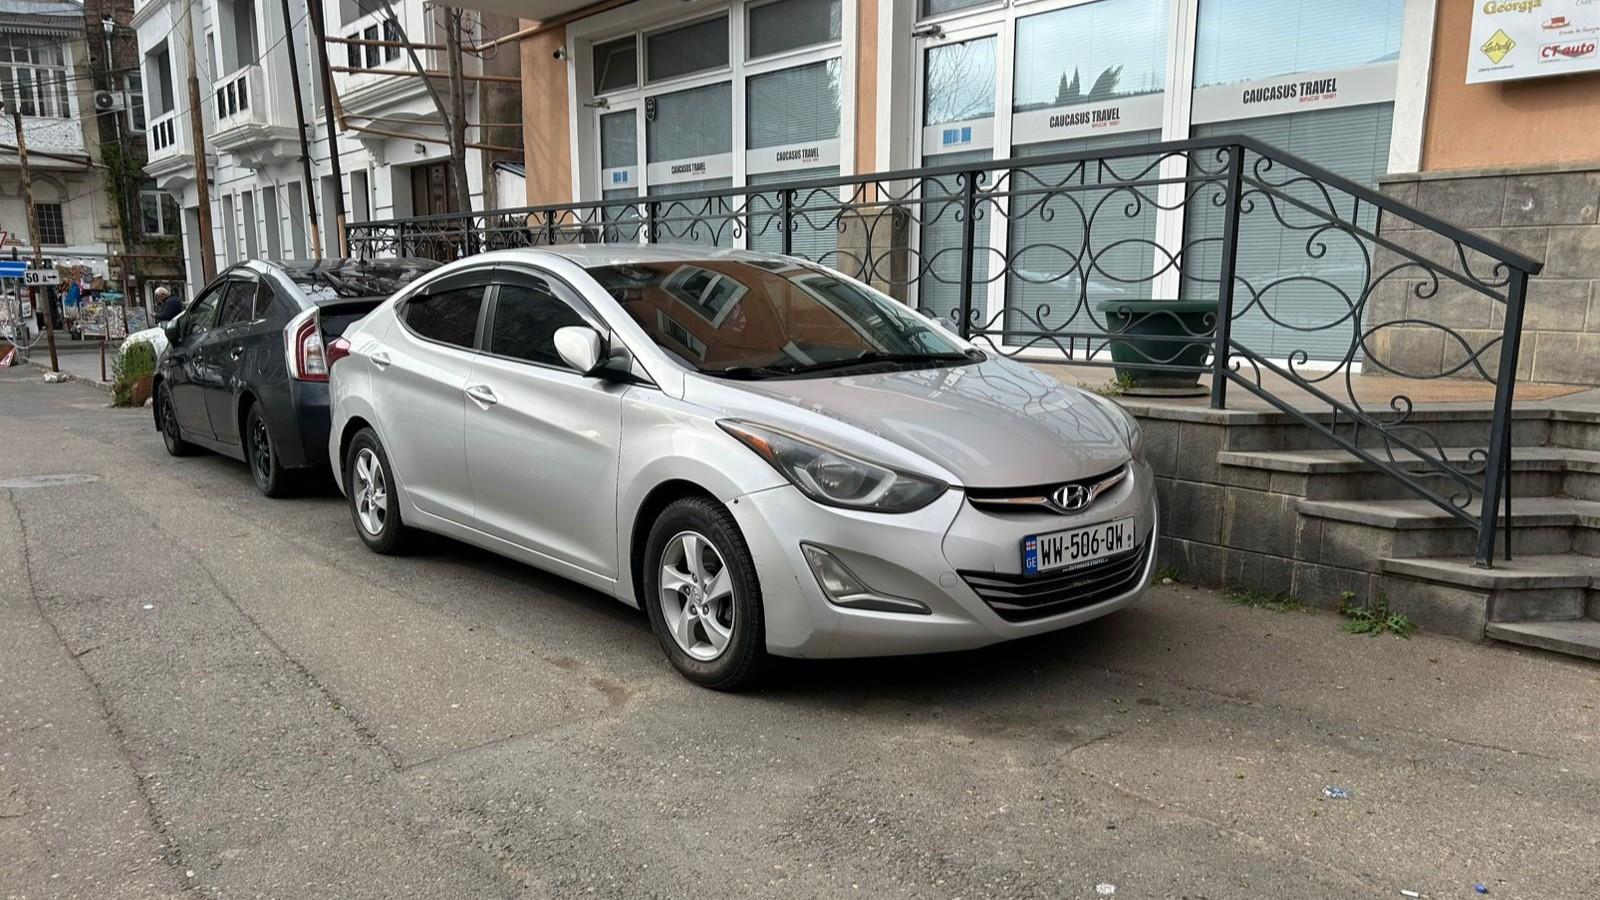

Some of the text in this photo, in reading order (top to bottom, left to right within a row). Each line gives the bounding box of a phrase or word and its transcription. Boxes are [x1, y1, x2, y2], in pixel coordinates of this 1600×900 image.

[1243, 82, 1297, 104] CAUCASUS
[1299, 77, 1337, 97] TRAVEL
[1049, 110, 1090, 128] CAUCASUS
[1092, 107, 1120, 123] TRAVEL
[776, 149, 801, 162] CAUCASUS
[802, 147, 819, 159] TRAVEL
[671, 163, 691, 174] CAUCASUS
[692, 161, 706, 171] TRAVEL
[25, 272, 39, 283] 50
[1040, 524, 1124, 566] WW-506-QW
[1026, 557, 1037, 568] GE
